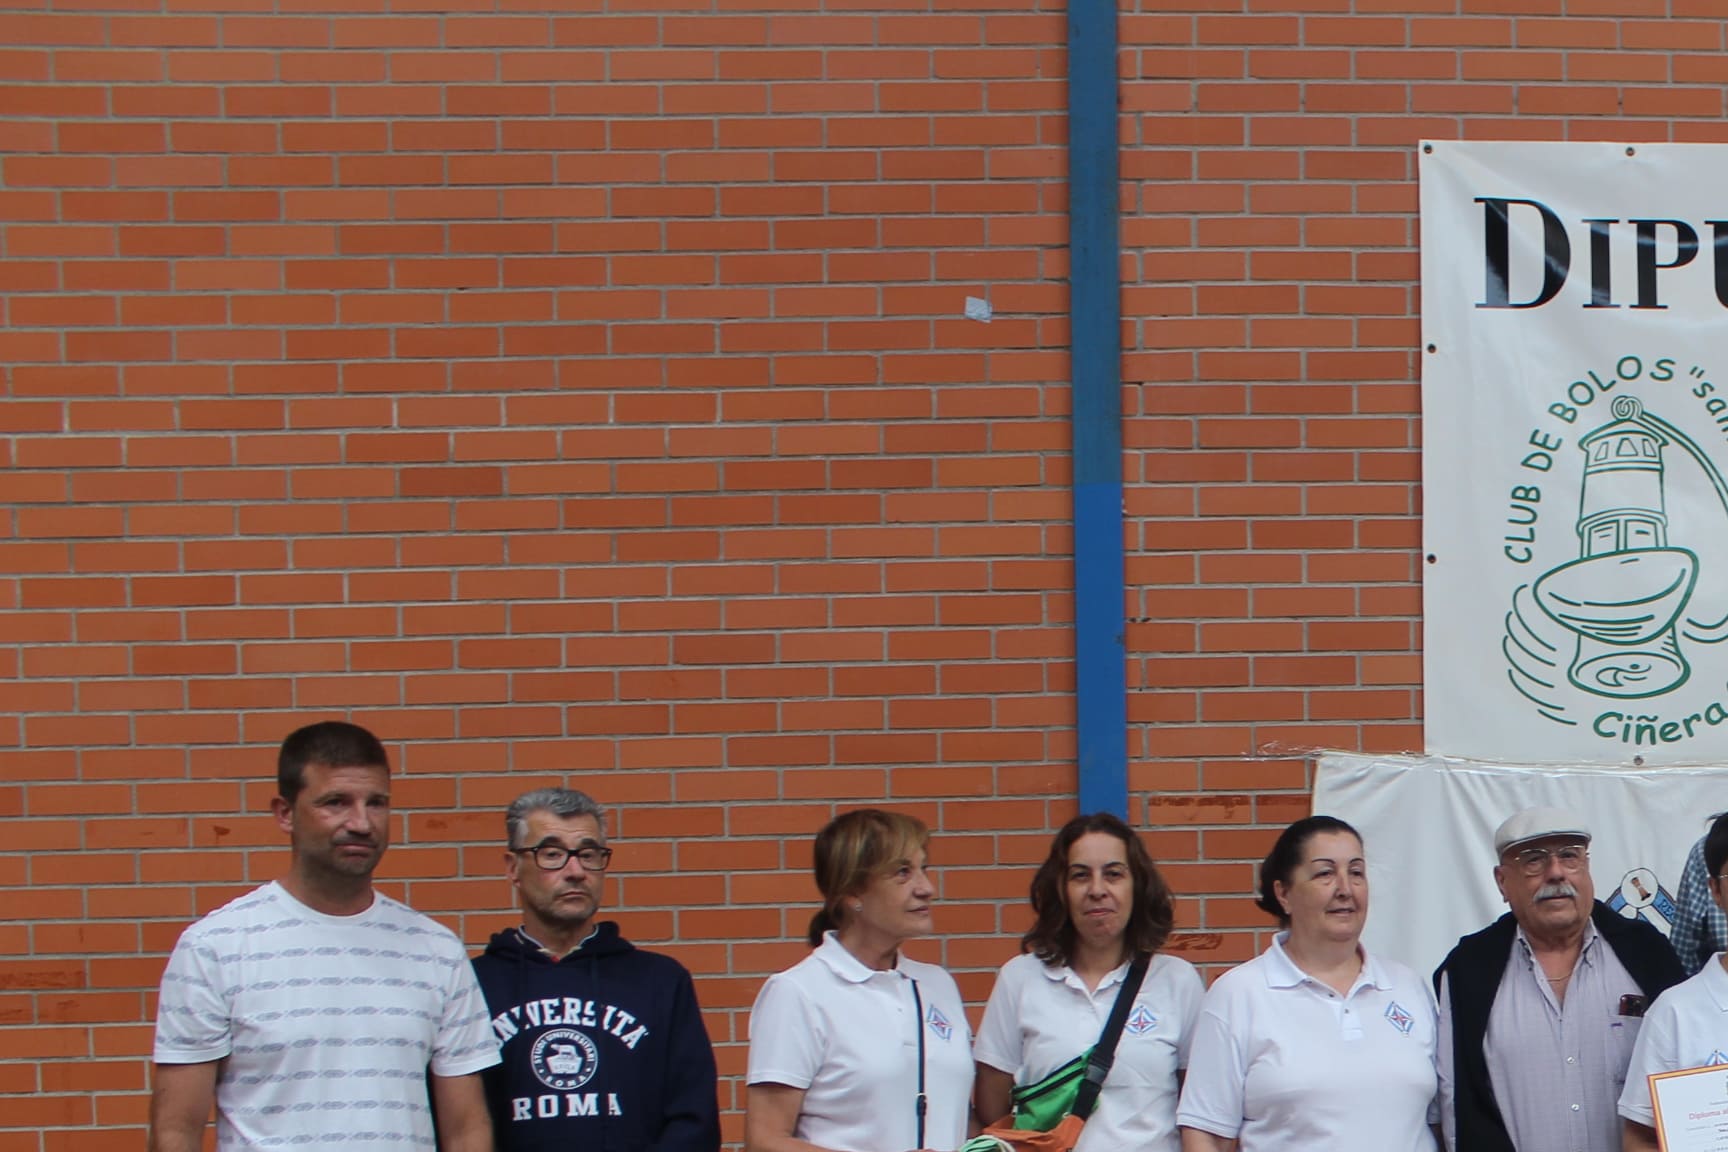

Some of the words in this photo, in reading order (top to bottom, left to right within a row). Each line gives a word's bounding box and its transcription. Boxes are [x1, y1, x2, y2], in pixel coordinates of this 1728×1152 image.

[1548, 355, 1677, 425] BOLOS
[1520, 428, 1563, 473] DE
[1504, 485, 1542, 564] CLUB
[512, 1092, 622, 1122] ROMA
